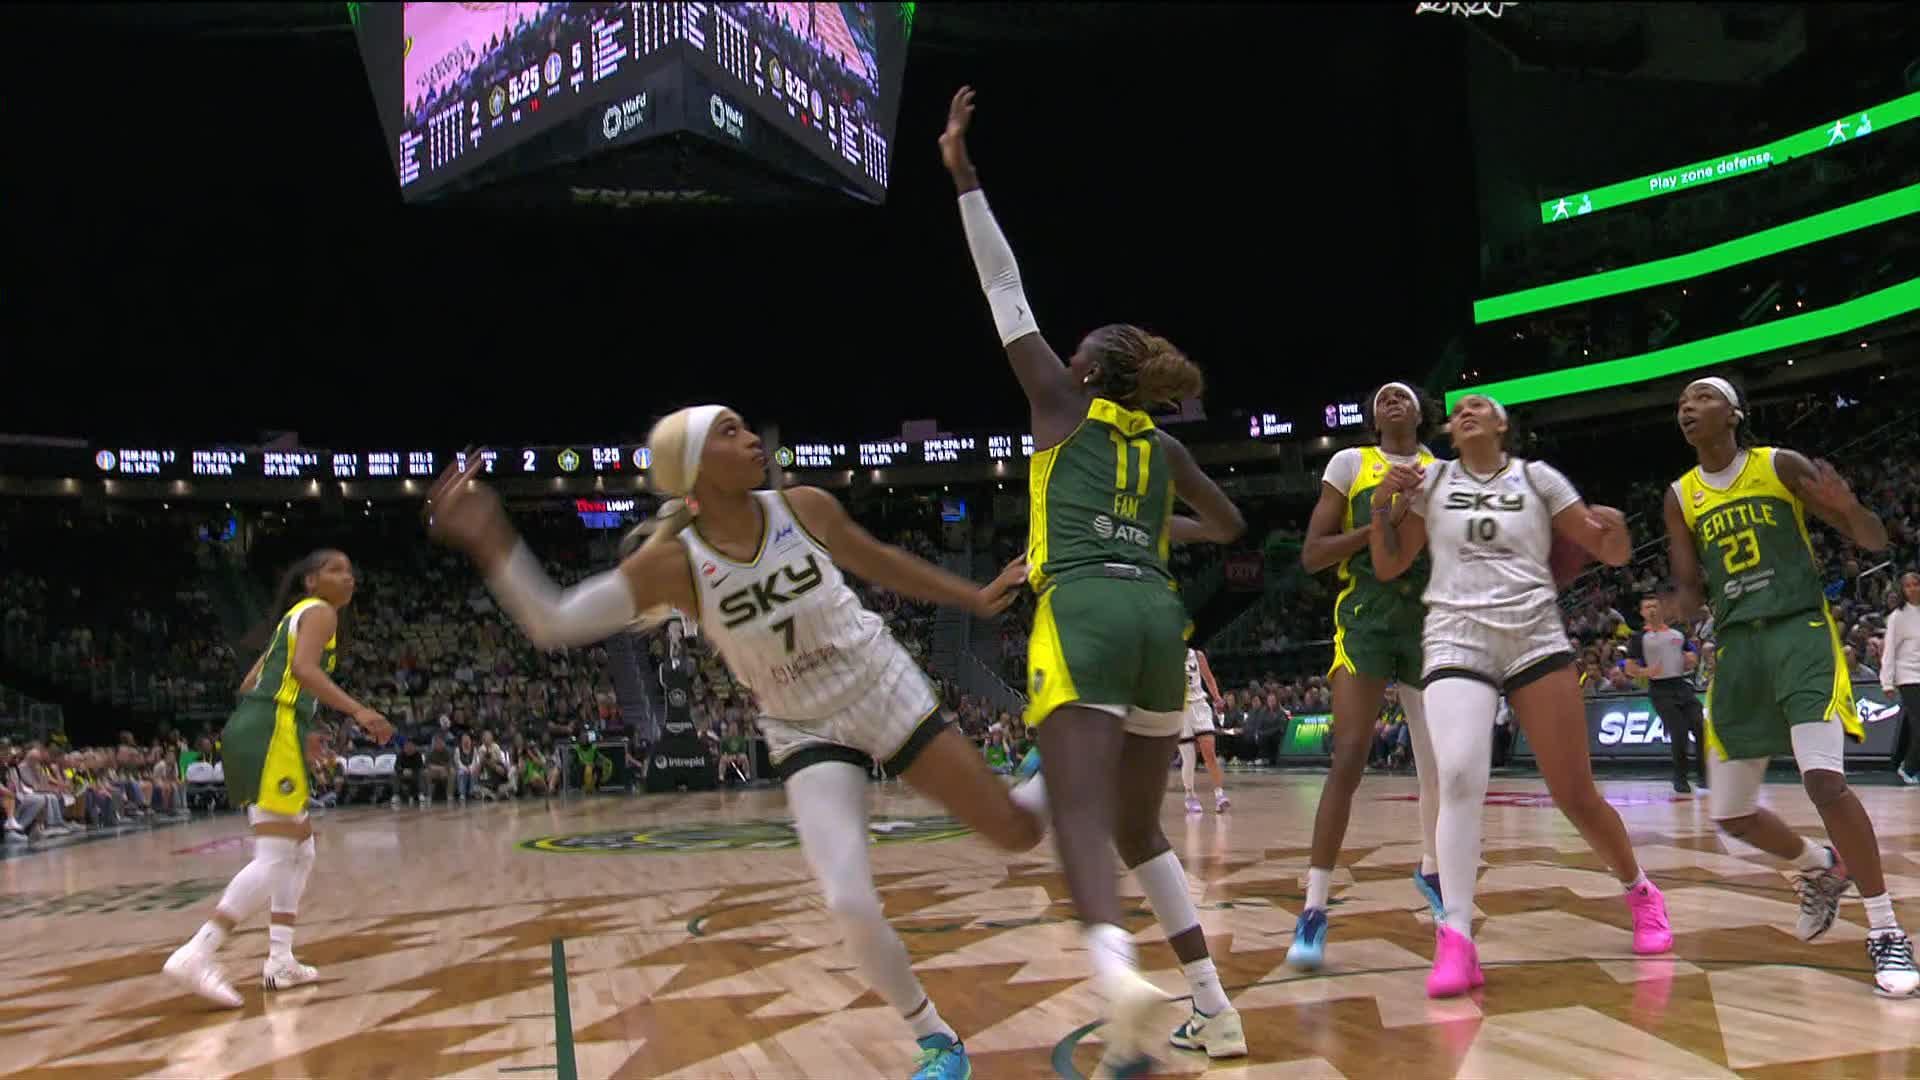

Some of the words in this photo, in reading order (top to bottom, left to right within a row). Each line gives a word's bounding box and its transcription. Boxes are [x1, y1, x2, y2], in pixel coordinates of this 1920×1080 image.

[509, 63, 540, 106] 5:25
[471, 100, 480, 126] 2
[622, 92, 647, 115] WaFd
[623, 110, 644, 132] Bank
[1649, 174, 1677, 192] Play
[1681, 166, 1713, 184] zone
[1717, 151, 1774, 175] defense.
[1264, 423, 1292, 436] Mercury
[1340, 413, 1363, 425] Dream
[523, 450, 536, 472] 2
[592, 448, 620, 463] 5:25
[1109, 430, 1152, 496] 11
[1444, 492, 1524, 511] SKY
[1467, 517, 1497, 542] 10
[1702, 503, 1777, 550] EATTLE
[1717, 528, 1761, 575] 23
[719, 552, 823, 629] SKY
[770, 615, 796, 653] 7
[668, 755, 705, 769] Intrepid
